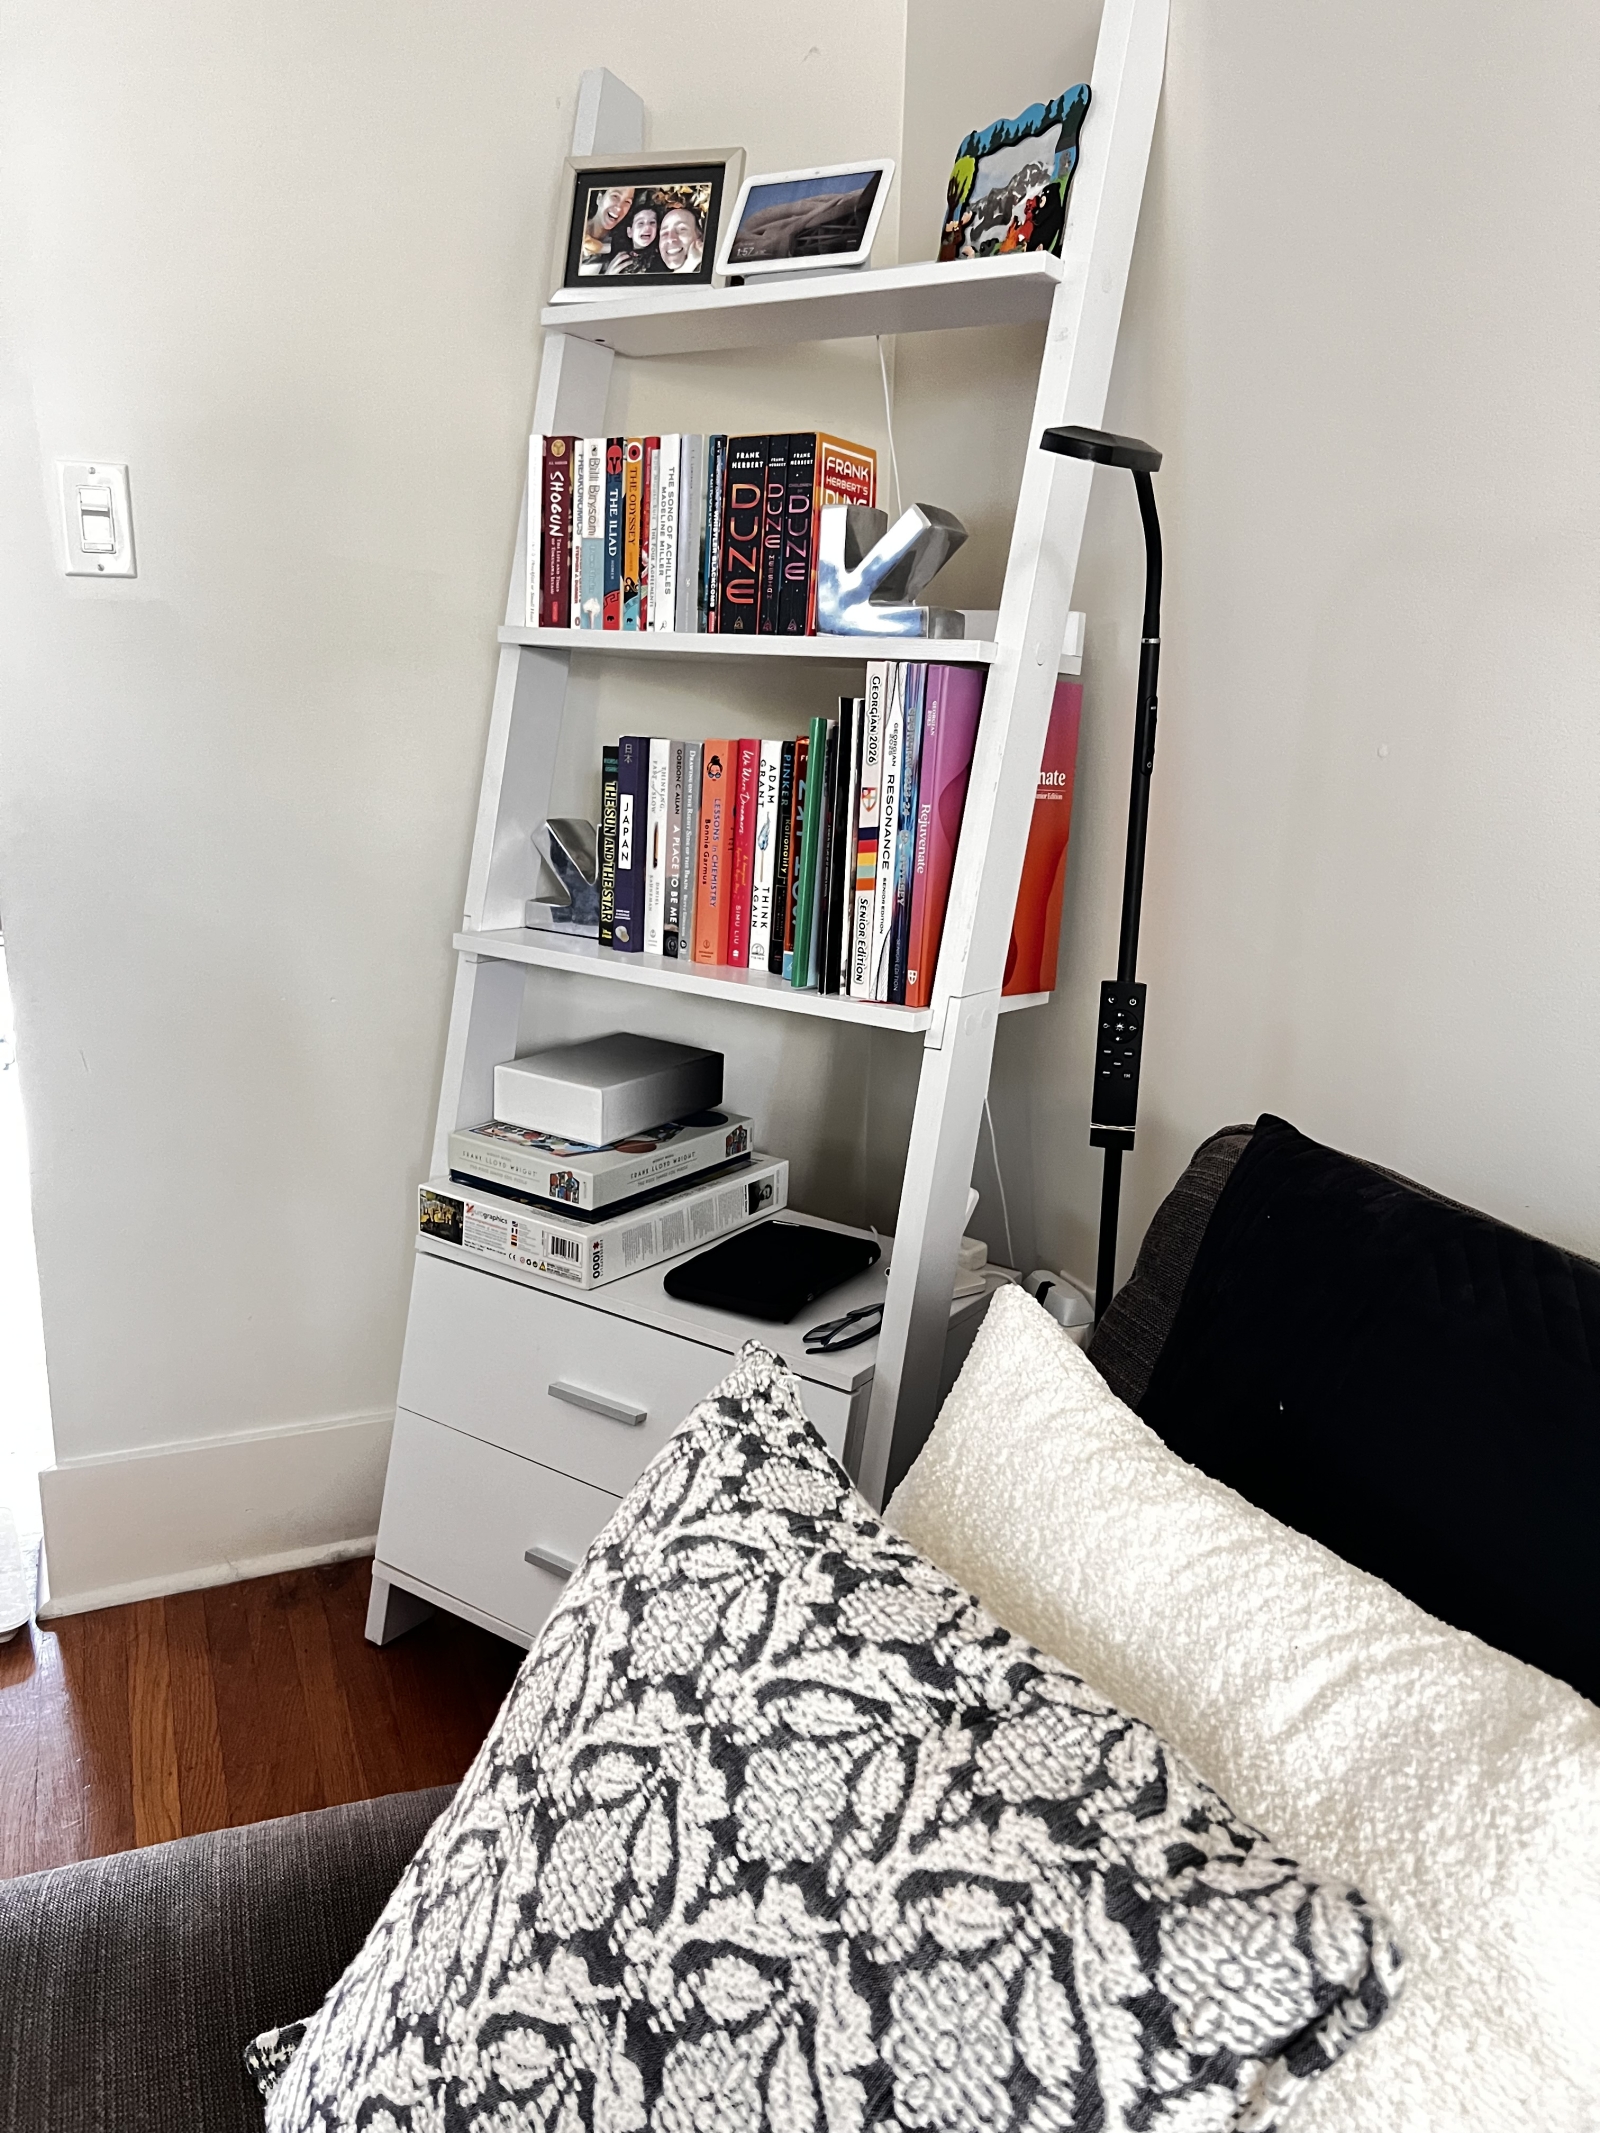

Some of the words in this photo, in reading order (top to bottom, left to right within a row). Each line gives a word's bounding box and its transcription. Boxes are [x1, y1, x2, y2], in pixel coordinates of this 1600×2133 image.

[588, 458, 600, 481] Bill
[732, 461, 764, 469] HERBERT
[826, 456, 868, 482] FRANK
[826, 476, 868, 496] HERBERT'S
[588, 484, 600, 536] Bryson
[609, 488, 618, 517] THE
[765, 484, 784, 548] DUNE
[628, 494, 636, 546] ODYSSEY
[666, 525, 673, 540] OF
[608, 520, 618, 556] ILIAD
[726, 484, 760, 604] DUNE
[784, 495, 810, 580] DUNE
[664, 543, 672, 595] ACHILLES
[743, 750, 754, 765] We
[869, 736, 877, 763] 2026
[605, 781, 618, 808] THE
[742, 768, 752, 791] Were
[758, 759, 766, 808] GRANT
[767, 765, 777, 804] ADAM
[781, 754, 791, 806] PINKER
[604, 808, 616, 836] SUN
[712, 798, 721, 841] LESSONS
[739, 792, 750, 834] Dreamers
[882, 775, 895, 870] RESONANCE
[621, 802, 630, 861] JAPAN
[673, 825, 680, 833] A
[917, 804, 931, 874] Rejuvenate
[604, 838, 614, 862] AND
[672, 838, 681, 869] PLACE
[781, 819, 790, 873] Rationality
[603, 862, 615, 888] THE
[671, 874, 679, 888] TO
[710, 855, 718, 907] CHEMISTRY
[602, 889, 614, 922] STAR
[670, 891, 678, 904] BE
[760, 886, 770, 929] THINK
[670, 907, 678, 923] ME
[485, 1155, 506, 1169] LLOYD
[510, 1164, 538, 1177] WRIGHT
[651, 1160, 670, 1172] LLOYD
